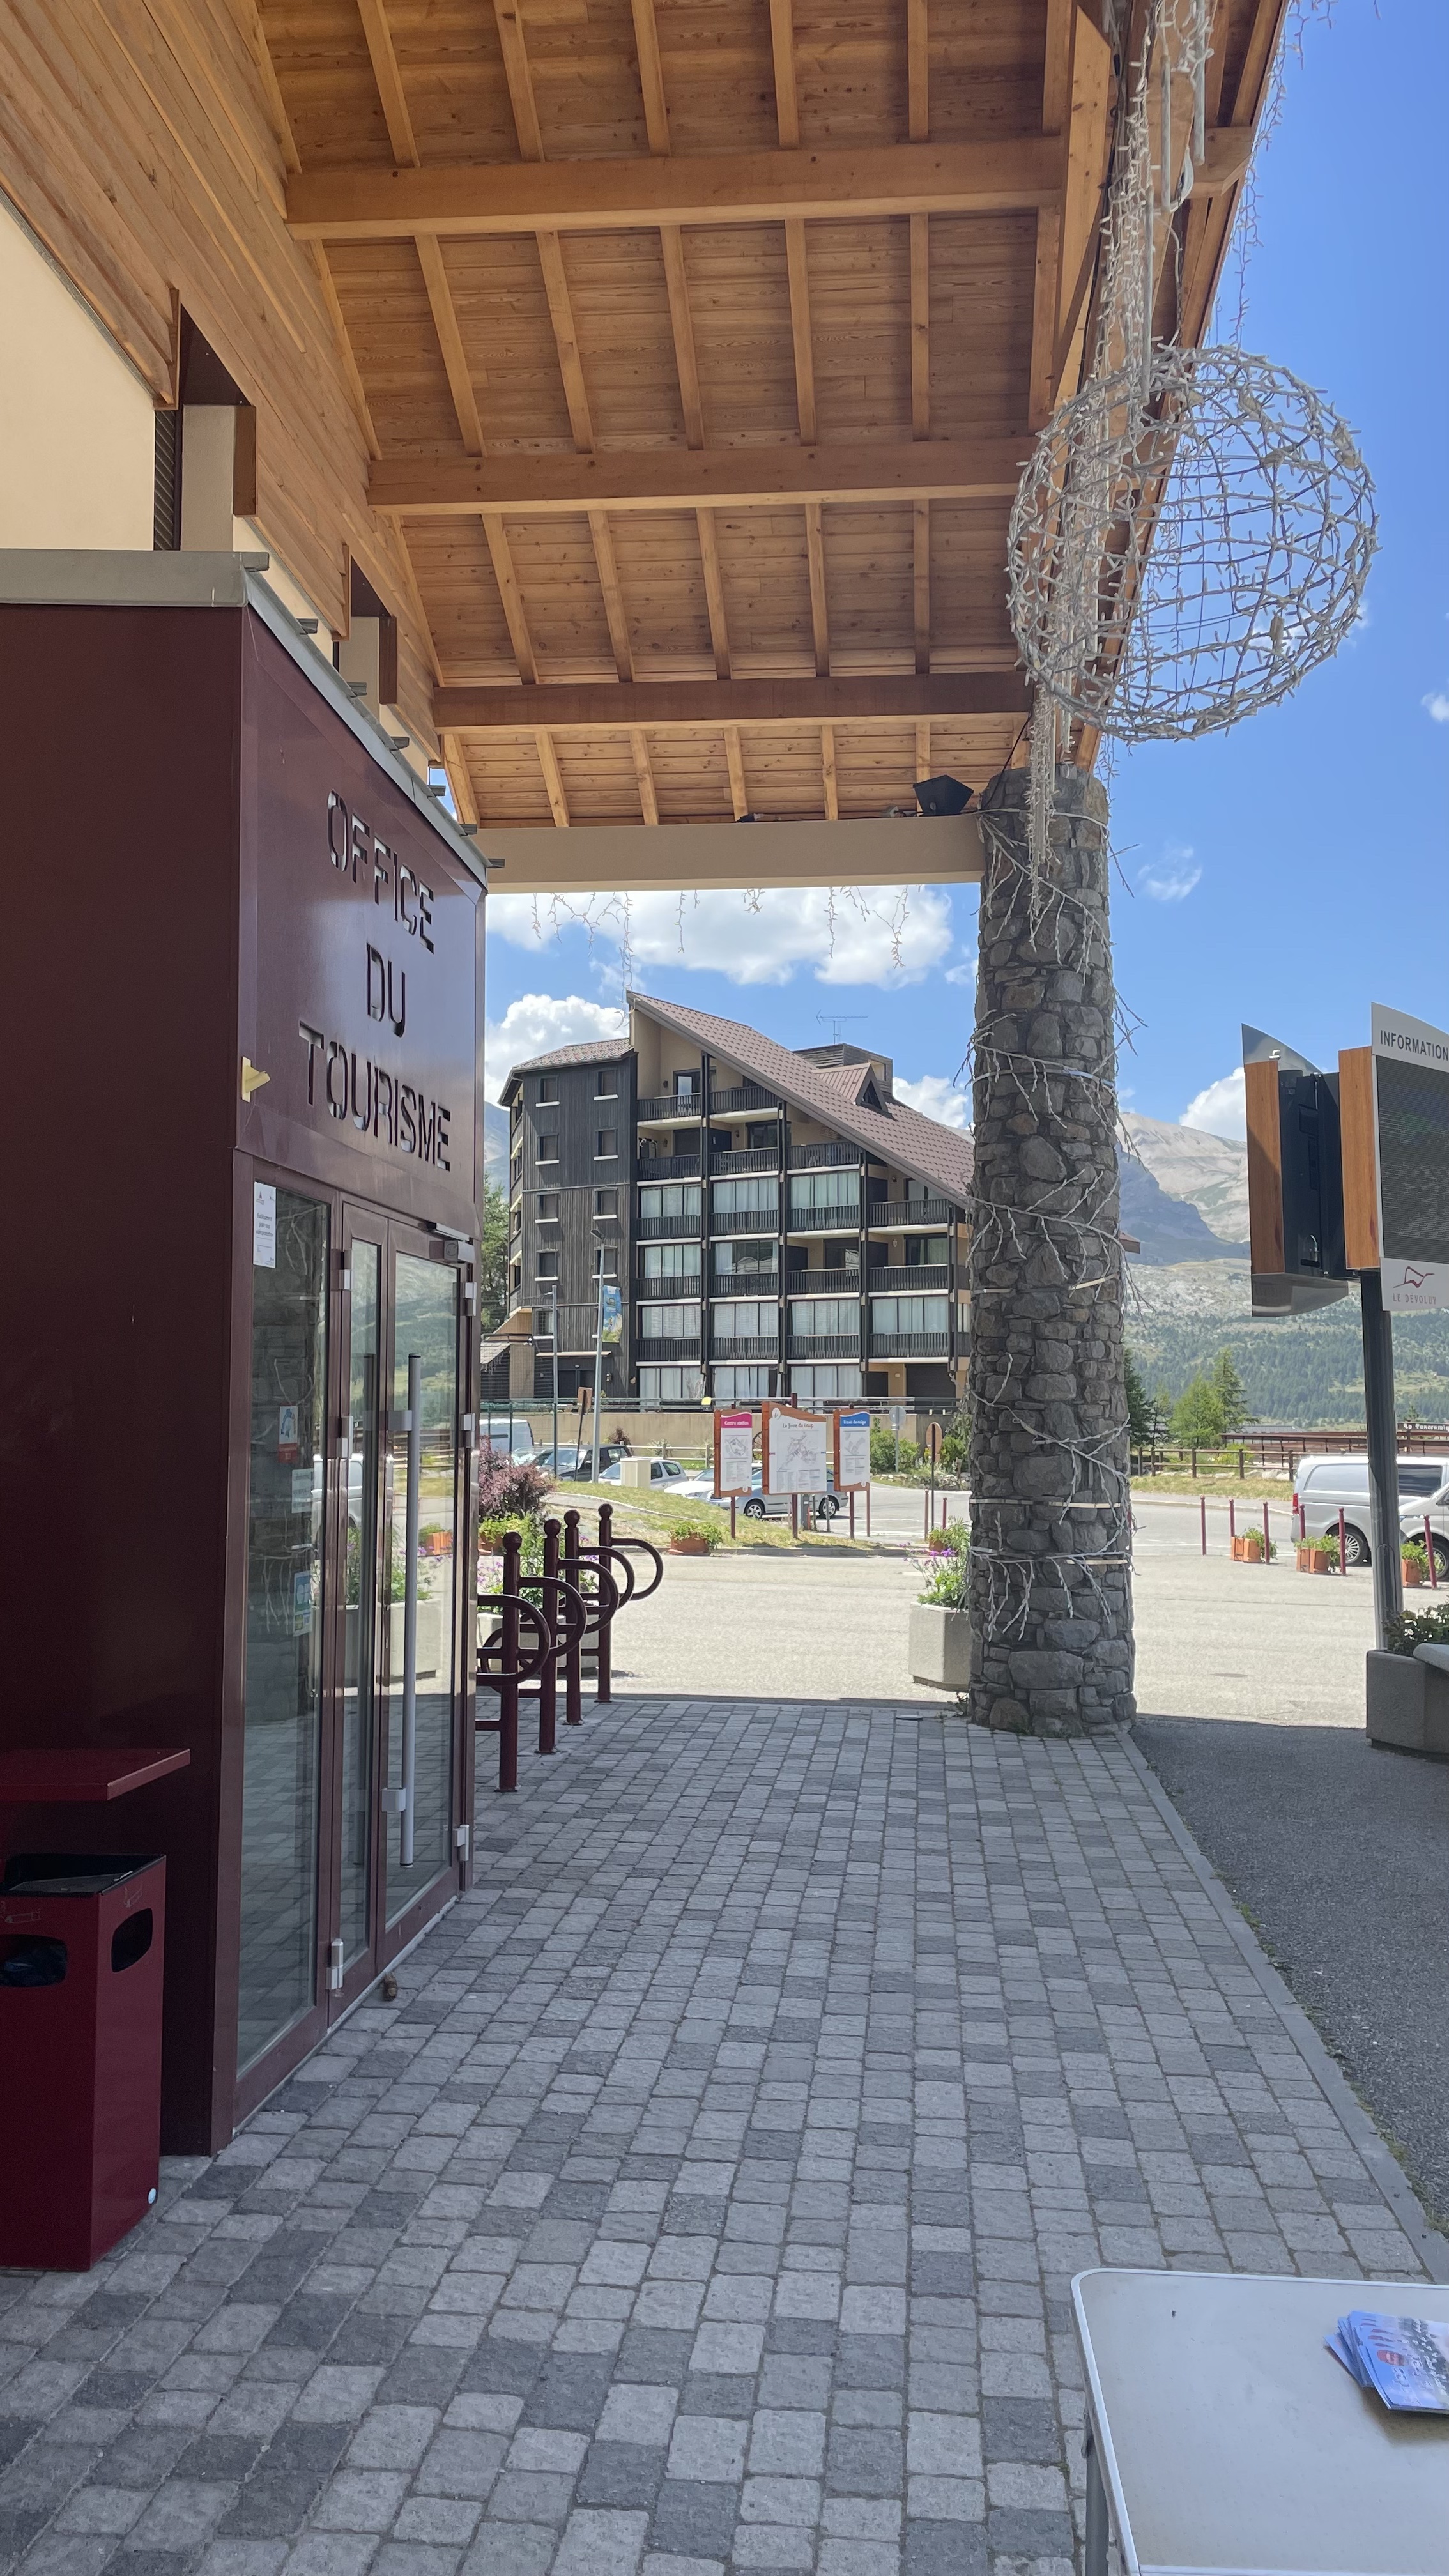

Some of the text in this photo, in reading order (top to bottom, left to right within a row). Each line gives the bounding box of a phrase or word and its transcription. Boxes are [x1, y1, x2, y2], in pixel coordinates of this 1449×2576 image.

[327, 790, 435, 954] OFFICE
[365, 942, 406, 1038] DU
[1381, 1030, 1448, 1061] INFORMATION
[298, 1021, 451, 1172] TOURISME
[1393, 1292, 1401, 1302] LE
